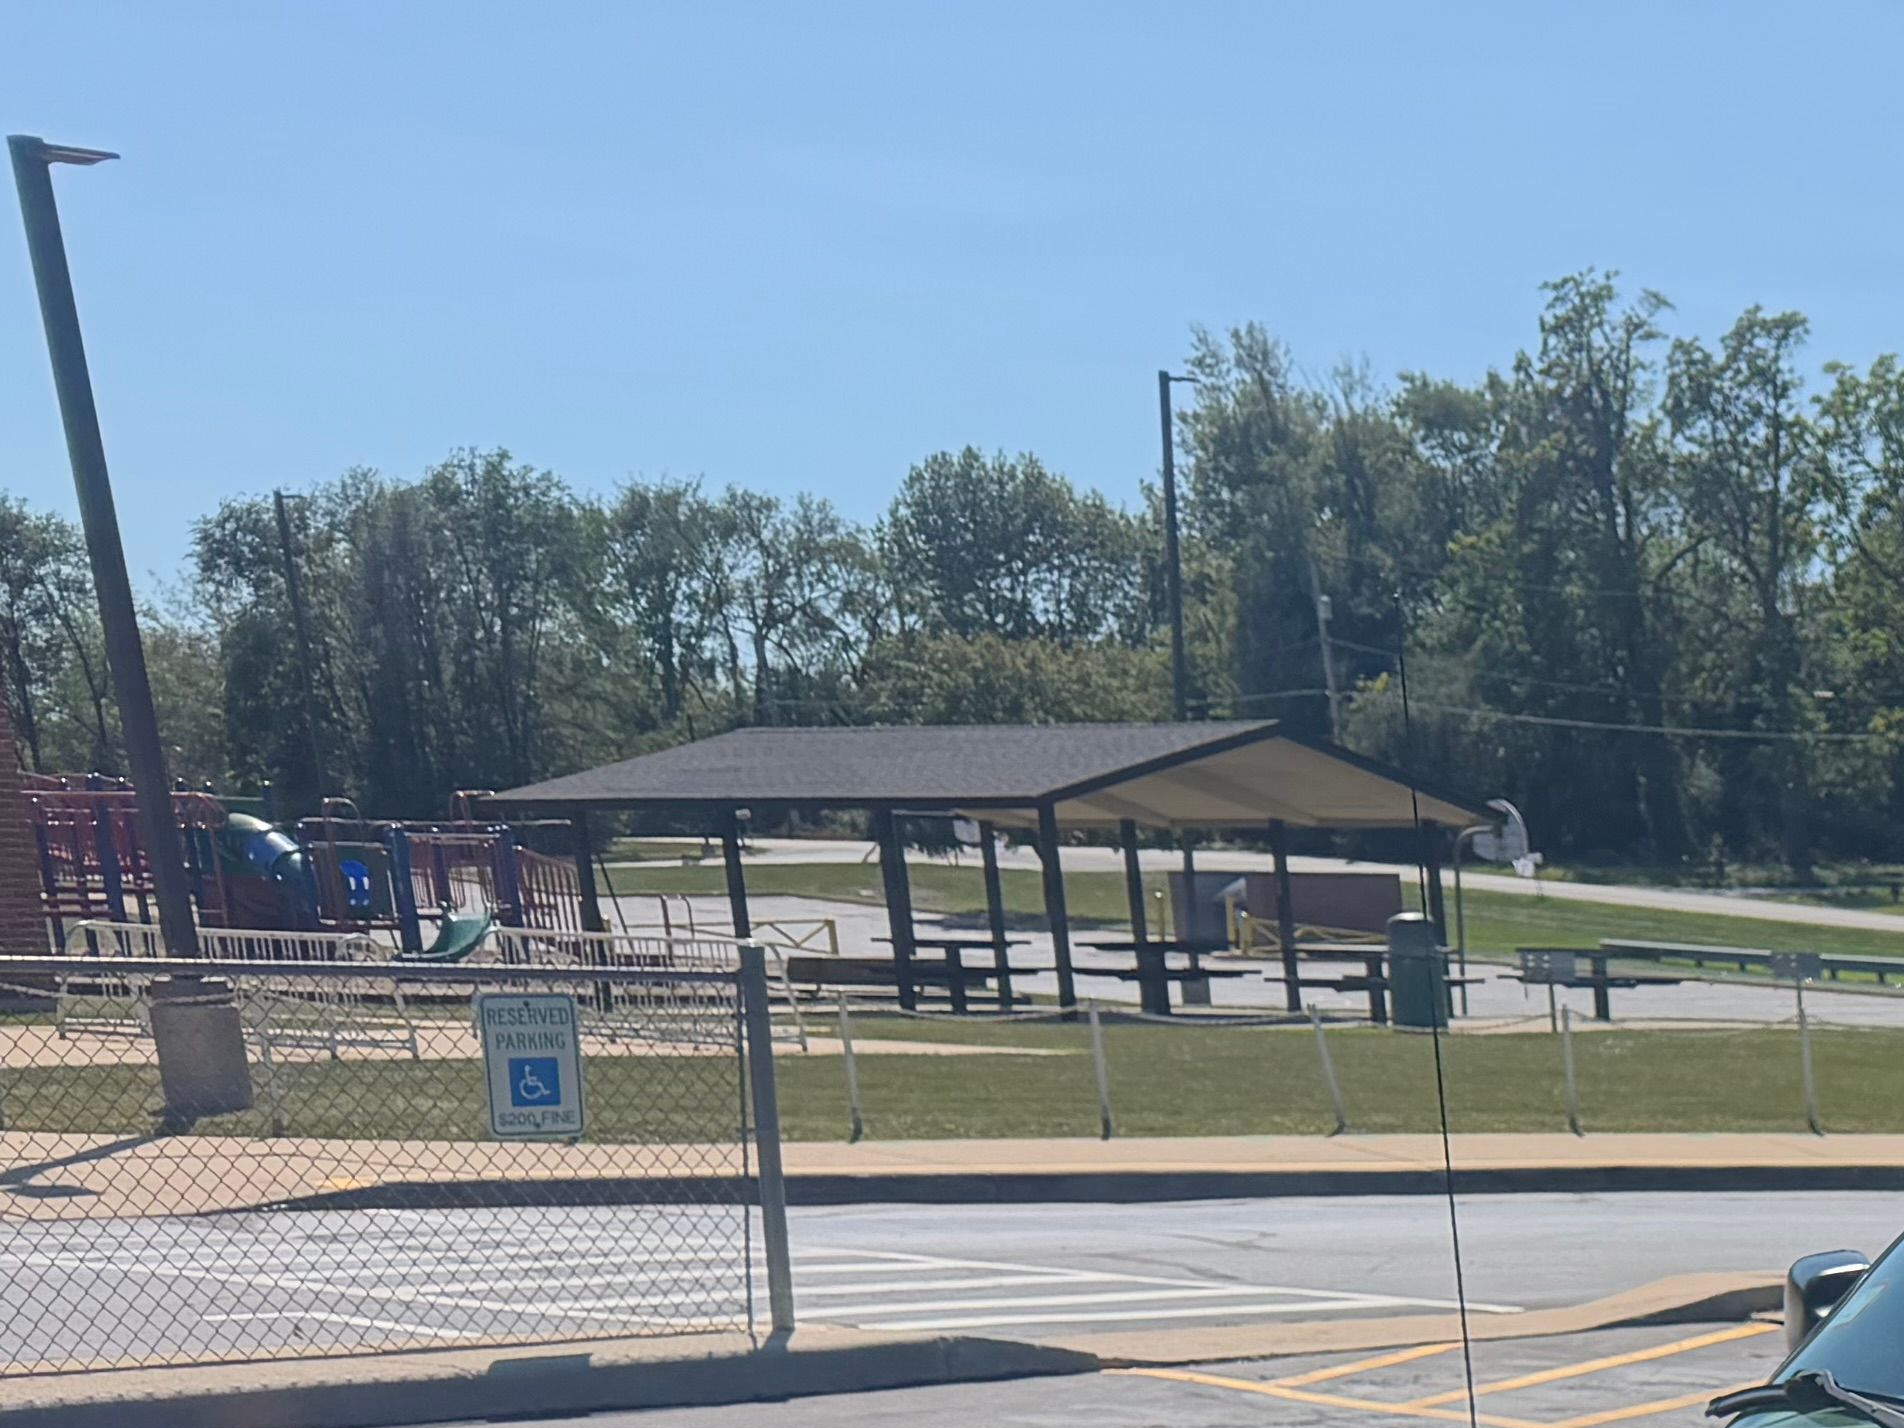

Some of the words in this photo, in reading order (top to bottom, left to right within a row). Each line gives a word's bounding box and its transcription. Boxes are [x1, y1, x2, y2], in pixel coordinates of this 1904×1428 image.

[486, 1007, 569, 1026] RESERVED
[495, 1032, 566, 1050] PARKING
[498, 1112, 537, 1127] $200
[541, 1110, 576, 1126] FINE
